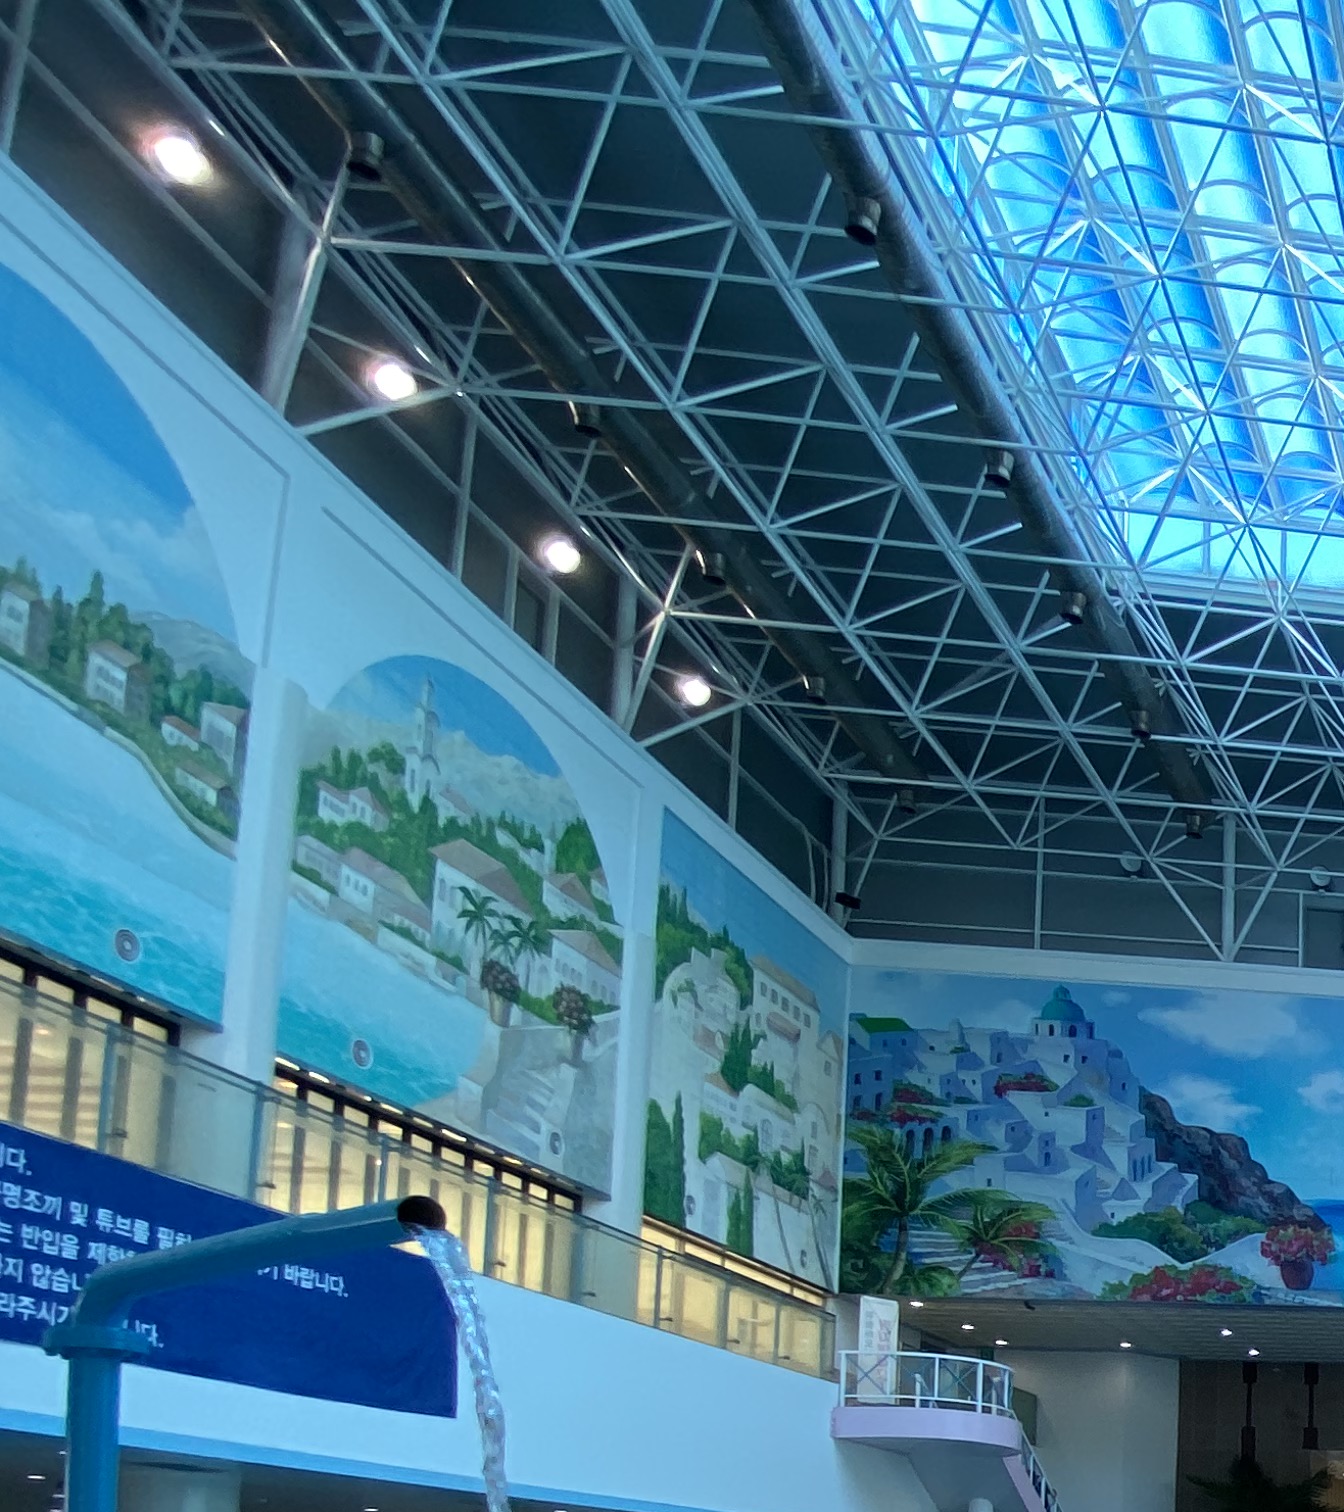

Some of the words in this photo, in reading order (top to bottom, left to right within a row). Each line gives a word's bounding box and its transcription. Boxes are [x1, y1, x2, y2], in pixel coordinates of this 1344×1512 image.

[21, 1223, 80, 1261] 반입을
[69, 1200, 89, 1228] 및
[95, 1207, 150, 1245] 튜브를
[283, 1263, 349, 1298] 바랍니다.
